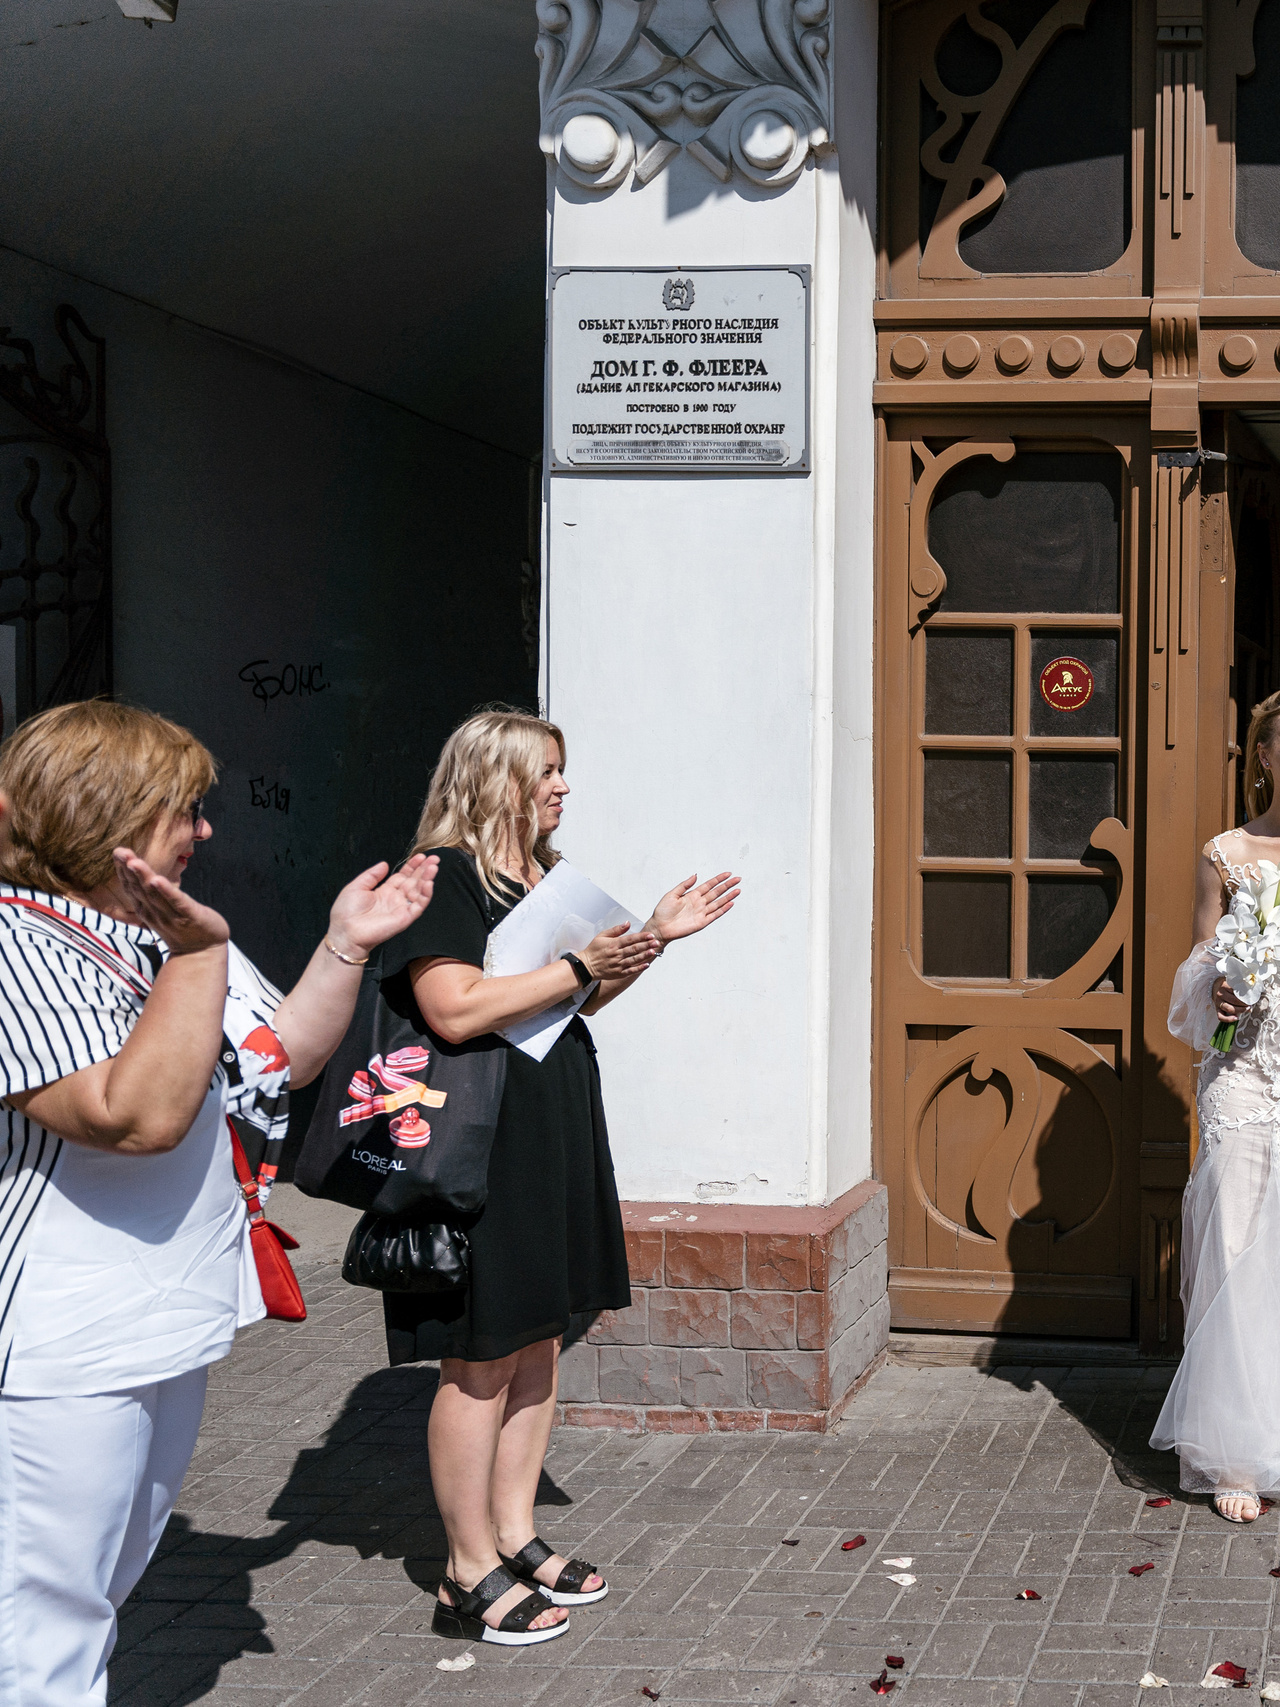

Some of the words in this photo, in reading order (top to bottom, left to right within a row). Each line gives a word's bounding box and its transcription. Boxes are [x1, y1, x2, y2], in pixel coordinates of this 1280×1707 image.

[578, 319, 625, 330] ОБЪЕКТ
[715, 318, 778, 331] НАСЛЕДИЯ
[603, 333, 697, 345] ФЕДЕРАЛЬНОГО
[701, 333, 762, 344] ЗНАЧЕНИЯ
[591, 361, 638, 380] ДОМ
[643, 360, 657, 376] Г.
[662, 360, 684, 376] Ф.
[689, 359, 768, 376] ФЛЕЕРА
[576, 383, 622, 394] (ЗДАНИЕ
[626, 383, 714, 393] АПТЕКАРСКОГО
[717, 381, 781, 393] МАГАЗИНА)
[626, 404, 679, 412] ПОСТРОЕНО
[683, 404, 689, 412] В
[692, 404, 708, 412] 1900
[713, 404, 736, 413] ГОДУ
[572, 424, 632, 436] ПОДЛЕЖИТ
[634, 422, 741, 435] ГОСУДАРСТВЕННОЙ
[352, 1149, 406, 1171] L'ORÉAL
[368, 1165, 387, 1175] PARIS
